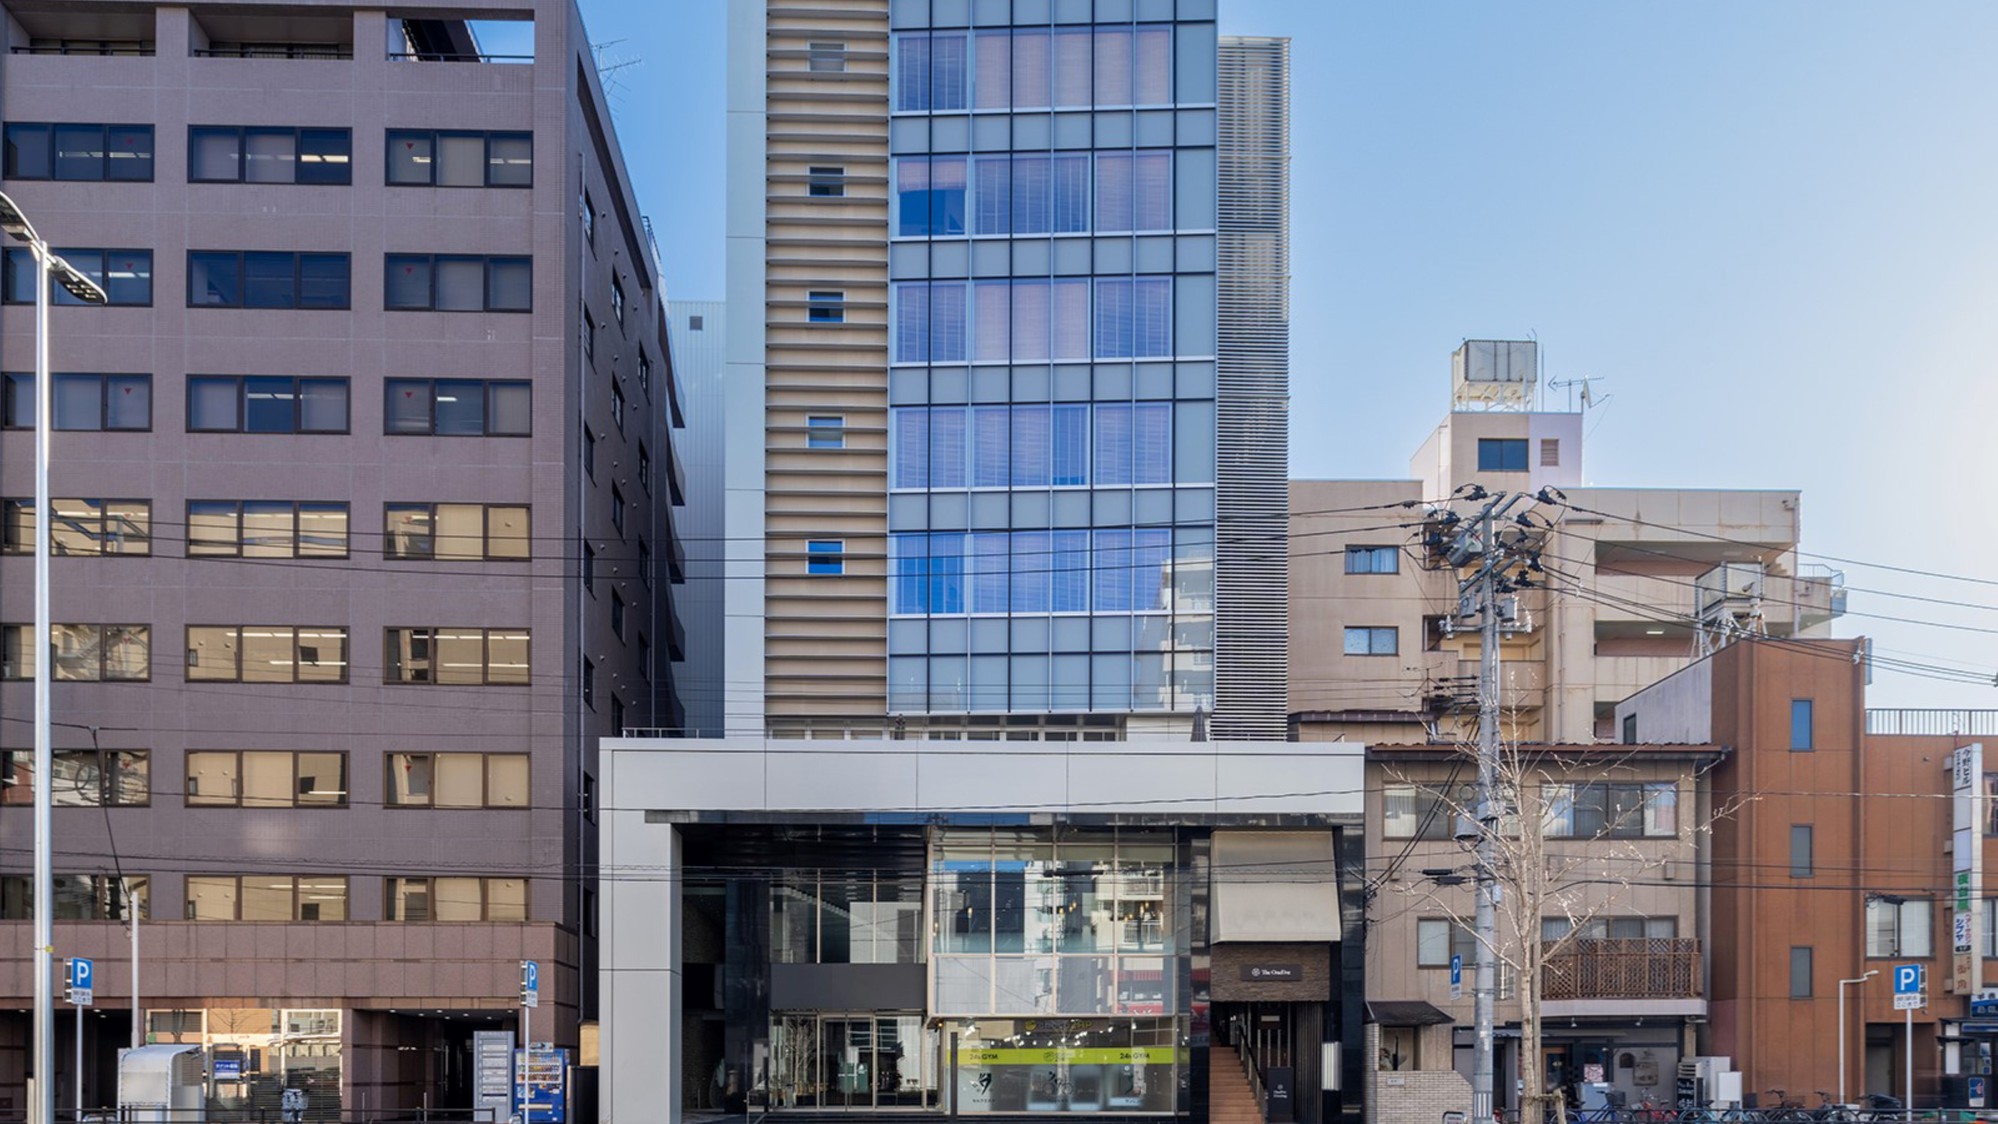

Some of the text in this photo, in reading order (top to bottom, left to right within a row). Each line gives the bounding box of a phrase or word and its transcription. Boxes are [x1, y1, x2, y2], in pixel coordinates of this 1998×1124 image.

[1956, 918, 1964, 941] シブヤ
[77, 961, 90, 985] P
[529, 964, 536, 987] P
[1452, 958, 1459, 982] P
[1900, 968, 1915, 991] P
